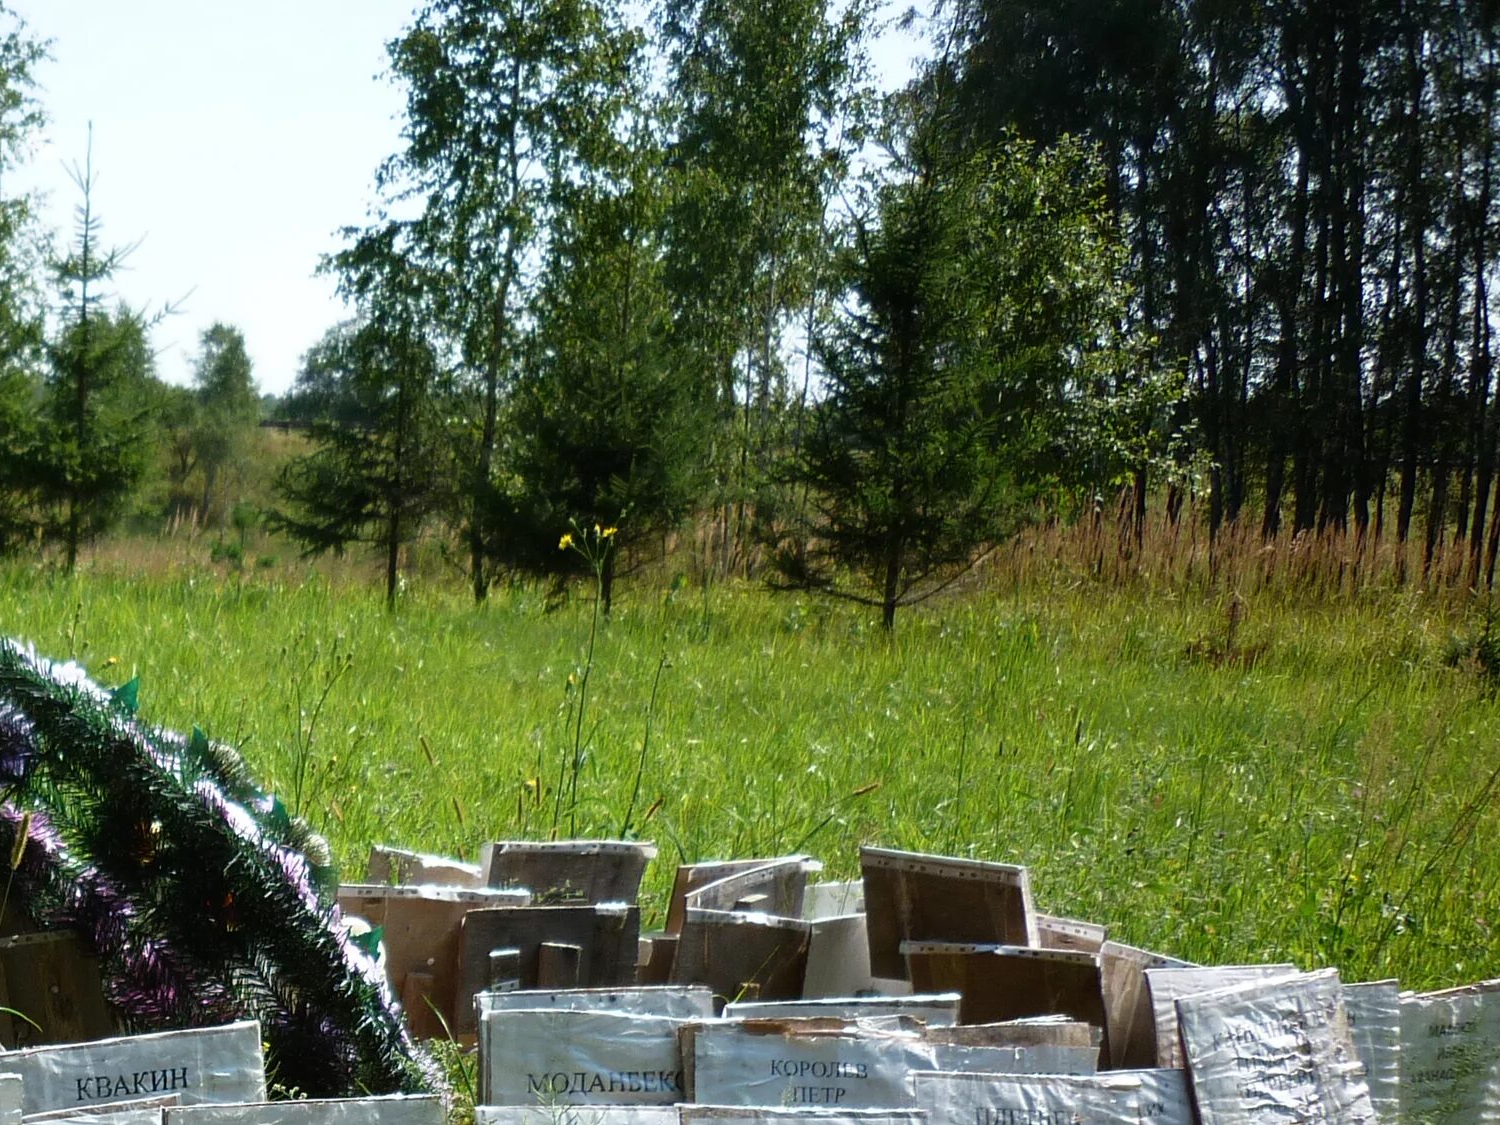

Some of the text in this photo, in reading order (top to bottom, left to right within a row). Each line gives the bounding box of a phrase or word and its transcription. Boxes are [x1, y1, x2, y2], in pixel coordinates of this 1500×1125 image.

[771, 1058, 869, 1080] КОРОЛЕВ
[75, 1066, 189, 1101] КВАКИН
[527, 1070, 684, 1096] МОДАНБЕКО
[793, 1086, 847, 1104] ПЕТР
